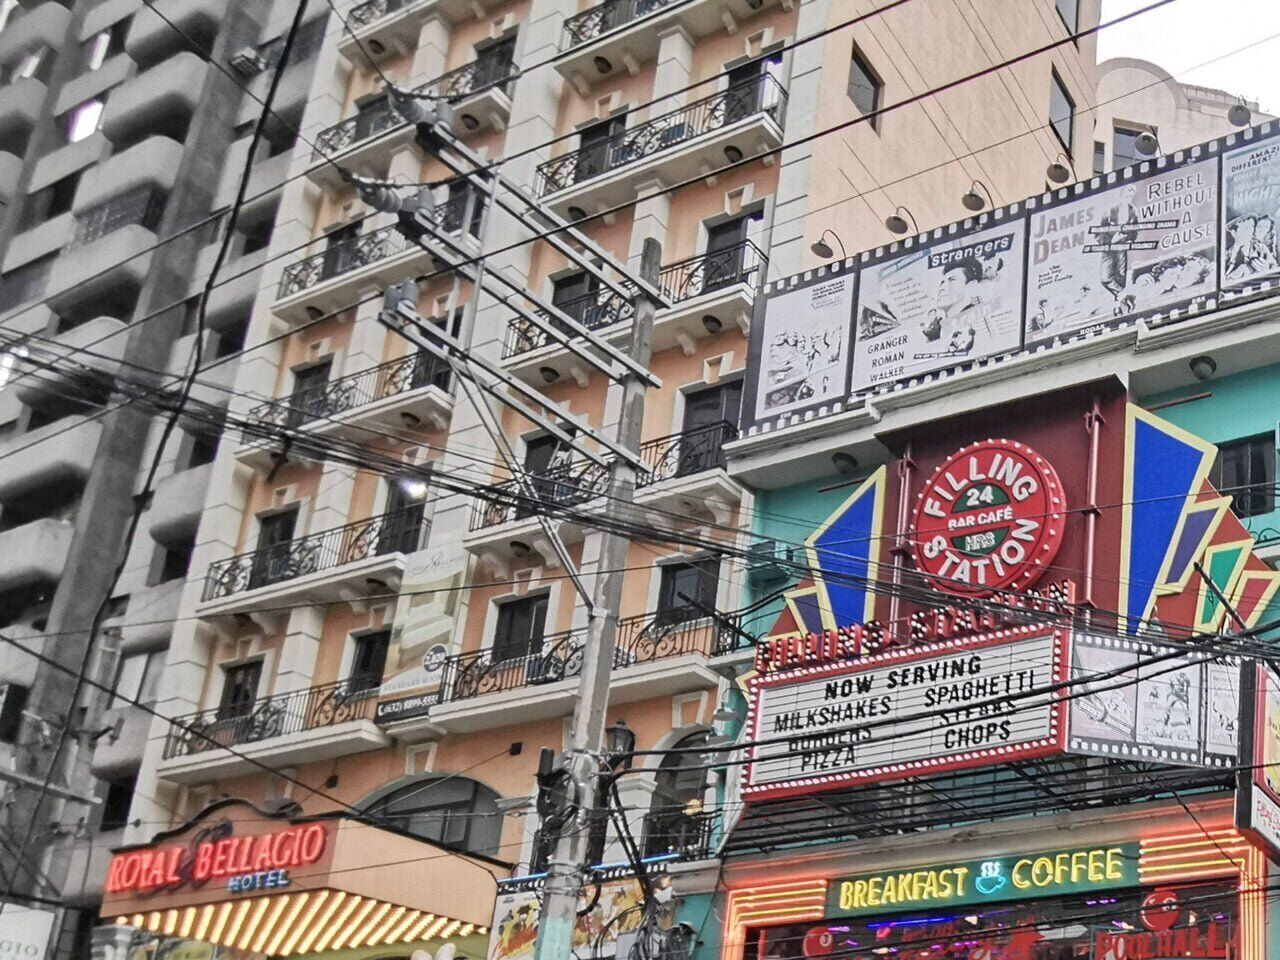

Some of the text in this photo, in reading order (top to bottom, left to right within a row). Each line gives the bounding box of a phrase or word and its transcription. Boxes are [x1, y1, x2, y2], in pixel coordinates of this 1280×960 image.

[1148, 172, 1204, 199] REBEL
[1140, 187, 1215, 219] WITHOUT
[1182, 211, 1192, 225] A
[1033, 206, 1096, 239] JAMES
[1161, 223, 1214, 249] CAUSE
[930, 236, 1010, 268] strangers
[1033, 231, 1085, 265] DEAN
[867, 334, 909, 354] GRANGER
[871, 351, 905, 369] ROMAN
[870, 366, 905, 383] WALKER
[923, 453, 1038, 518] FILLING
[966, 485, 994, 507] 24
[947, 506, 1014, 531] BAR CAFÉ
[923, 518, 1039, 584] STATION
[964, 531, 996, 552] HRS
[824, 655, 983, 701] NOW SERVING
[773, 669, 1036, 733] MILKSHAKES SPAGHETTI
[800, 719, 1013, 773] PIZZA CHOPS
[105, 824, 328, 893] ROYAL BELLAGIO
[227, 868, 292, 892] HOTEL
[839, 848, 1123, 910] BREAKFAST COFFEE
